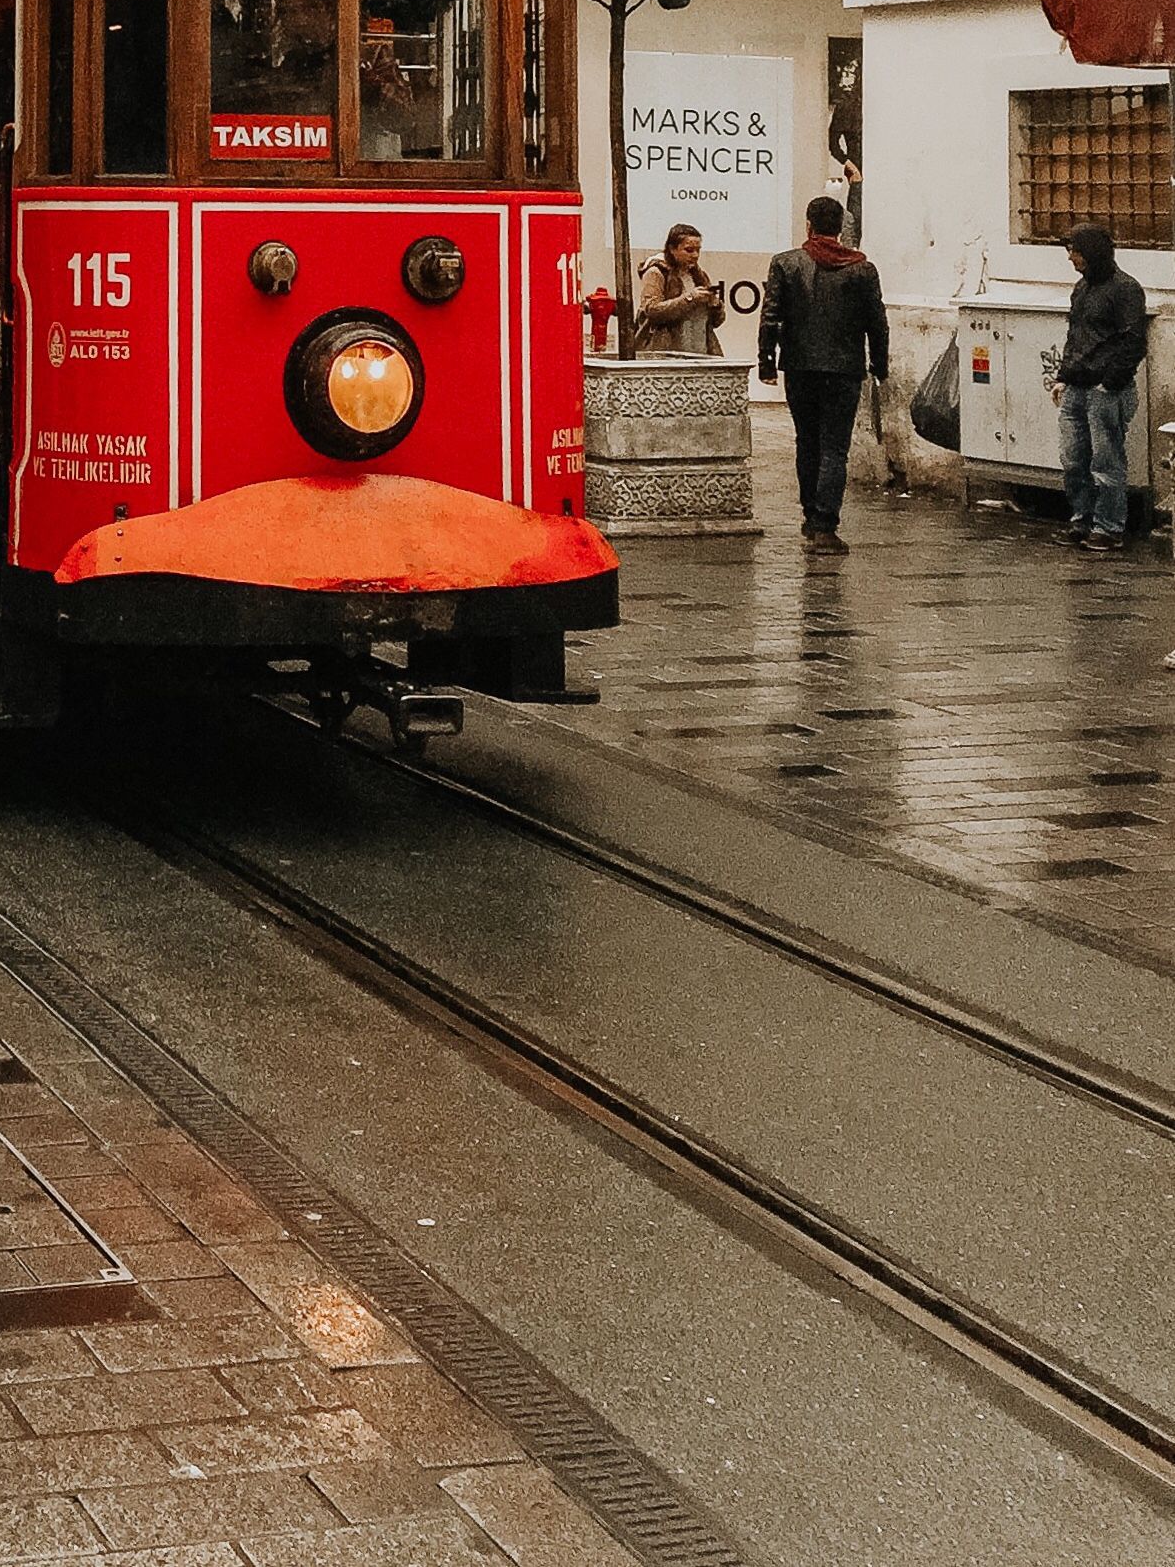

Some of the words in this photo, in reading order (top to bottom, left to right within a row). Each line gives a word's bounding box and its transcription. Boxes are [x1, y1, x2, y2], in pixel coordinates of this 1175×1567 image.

[213, 122, 327, 147] TAKSİM
[632, 107, 740, 136] MARKS
[748, 112, 767, 137] &
[626, 145, 773, 174] SPENCER
[671, 189, 728, 201] LONDON
[67, 253, 130, 307] 115
[70, 344, 98, 359] ALO
[103, 345, 130, 360] 153
[37, 431, 88, 454] ASILMAK
[96, 434, 147, 457] YASAK
[33, 456, 46, 478] VE
[547, 455, 561, 476] VE
